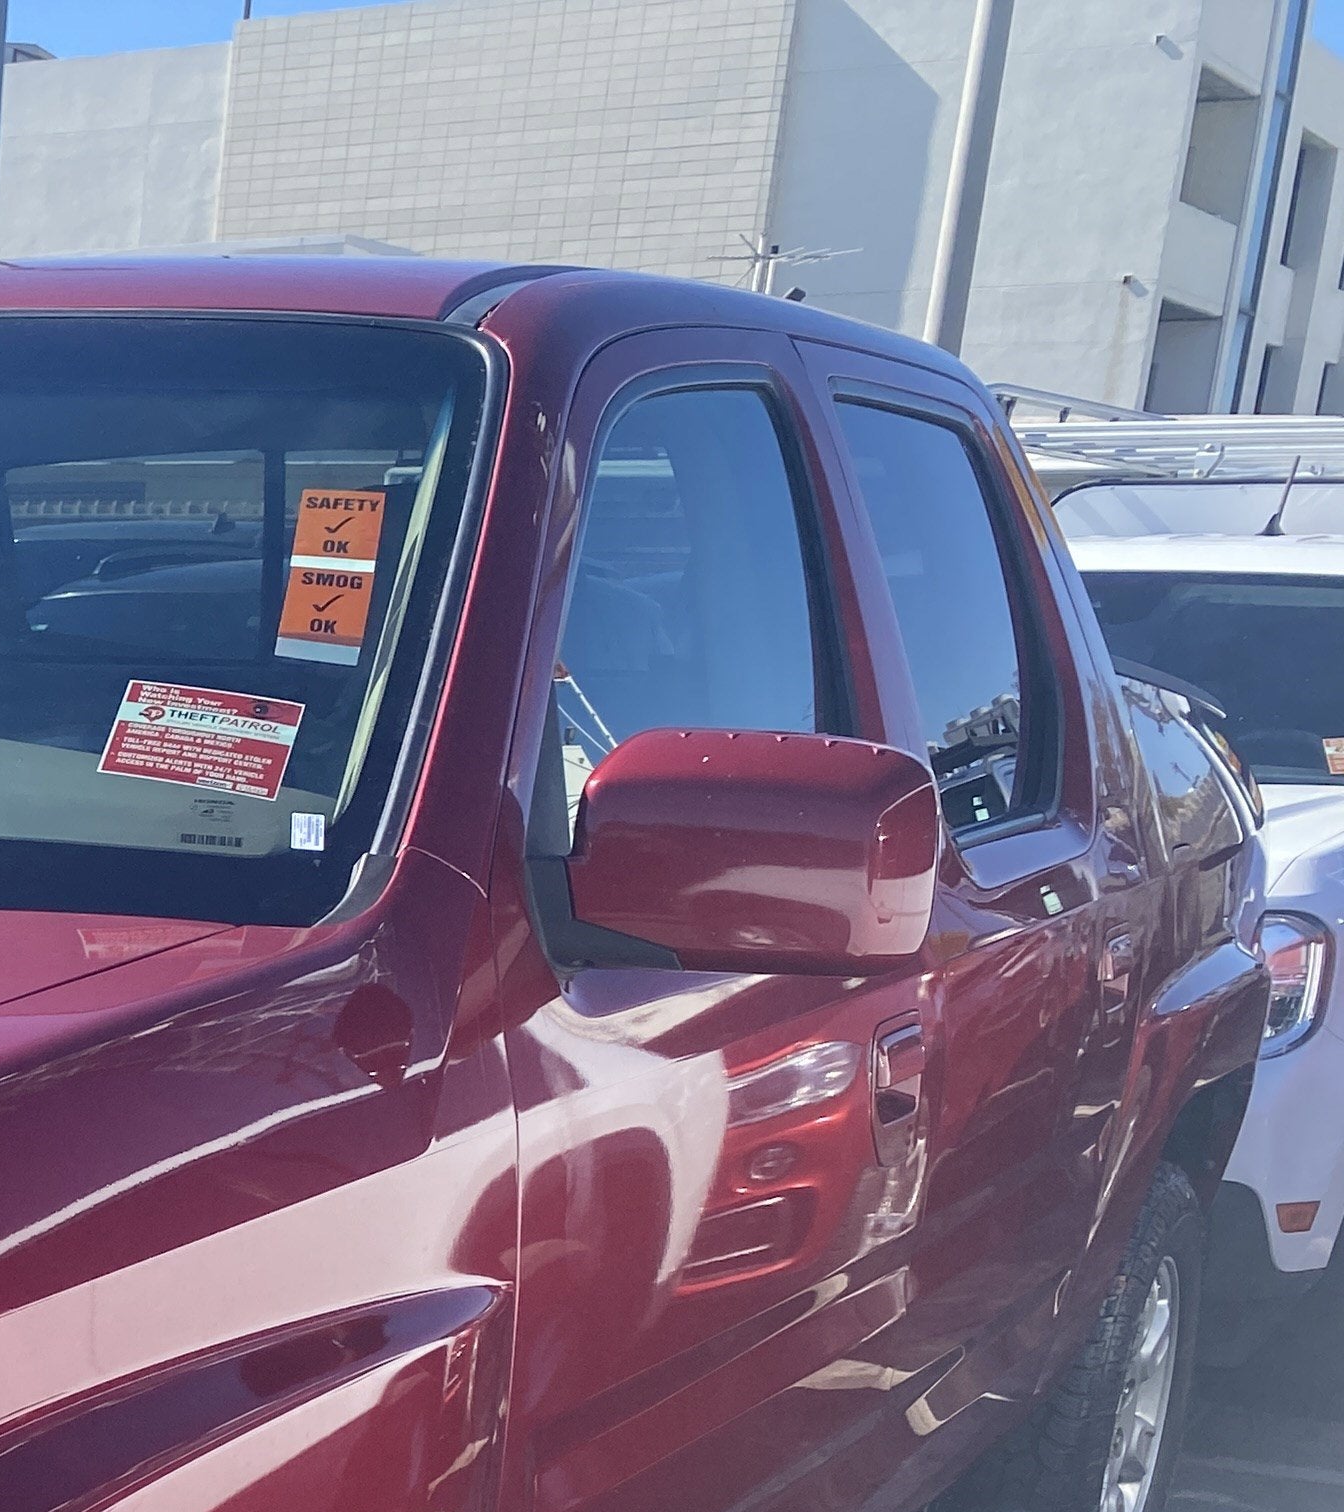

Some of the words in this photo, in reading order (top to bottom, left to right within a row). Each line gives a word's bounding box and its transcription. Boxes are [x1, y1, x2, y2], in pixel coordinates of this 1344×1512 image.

[306, 496, 380, 512] SAFETY
[322, 540, 350, 553] OK
[301, 572, 363, 589] SMOG
[309, 618, 337, 634] OK
